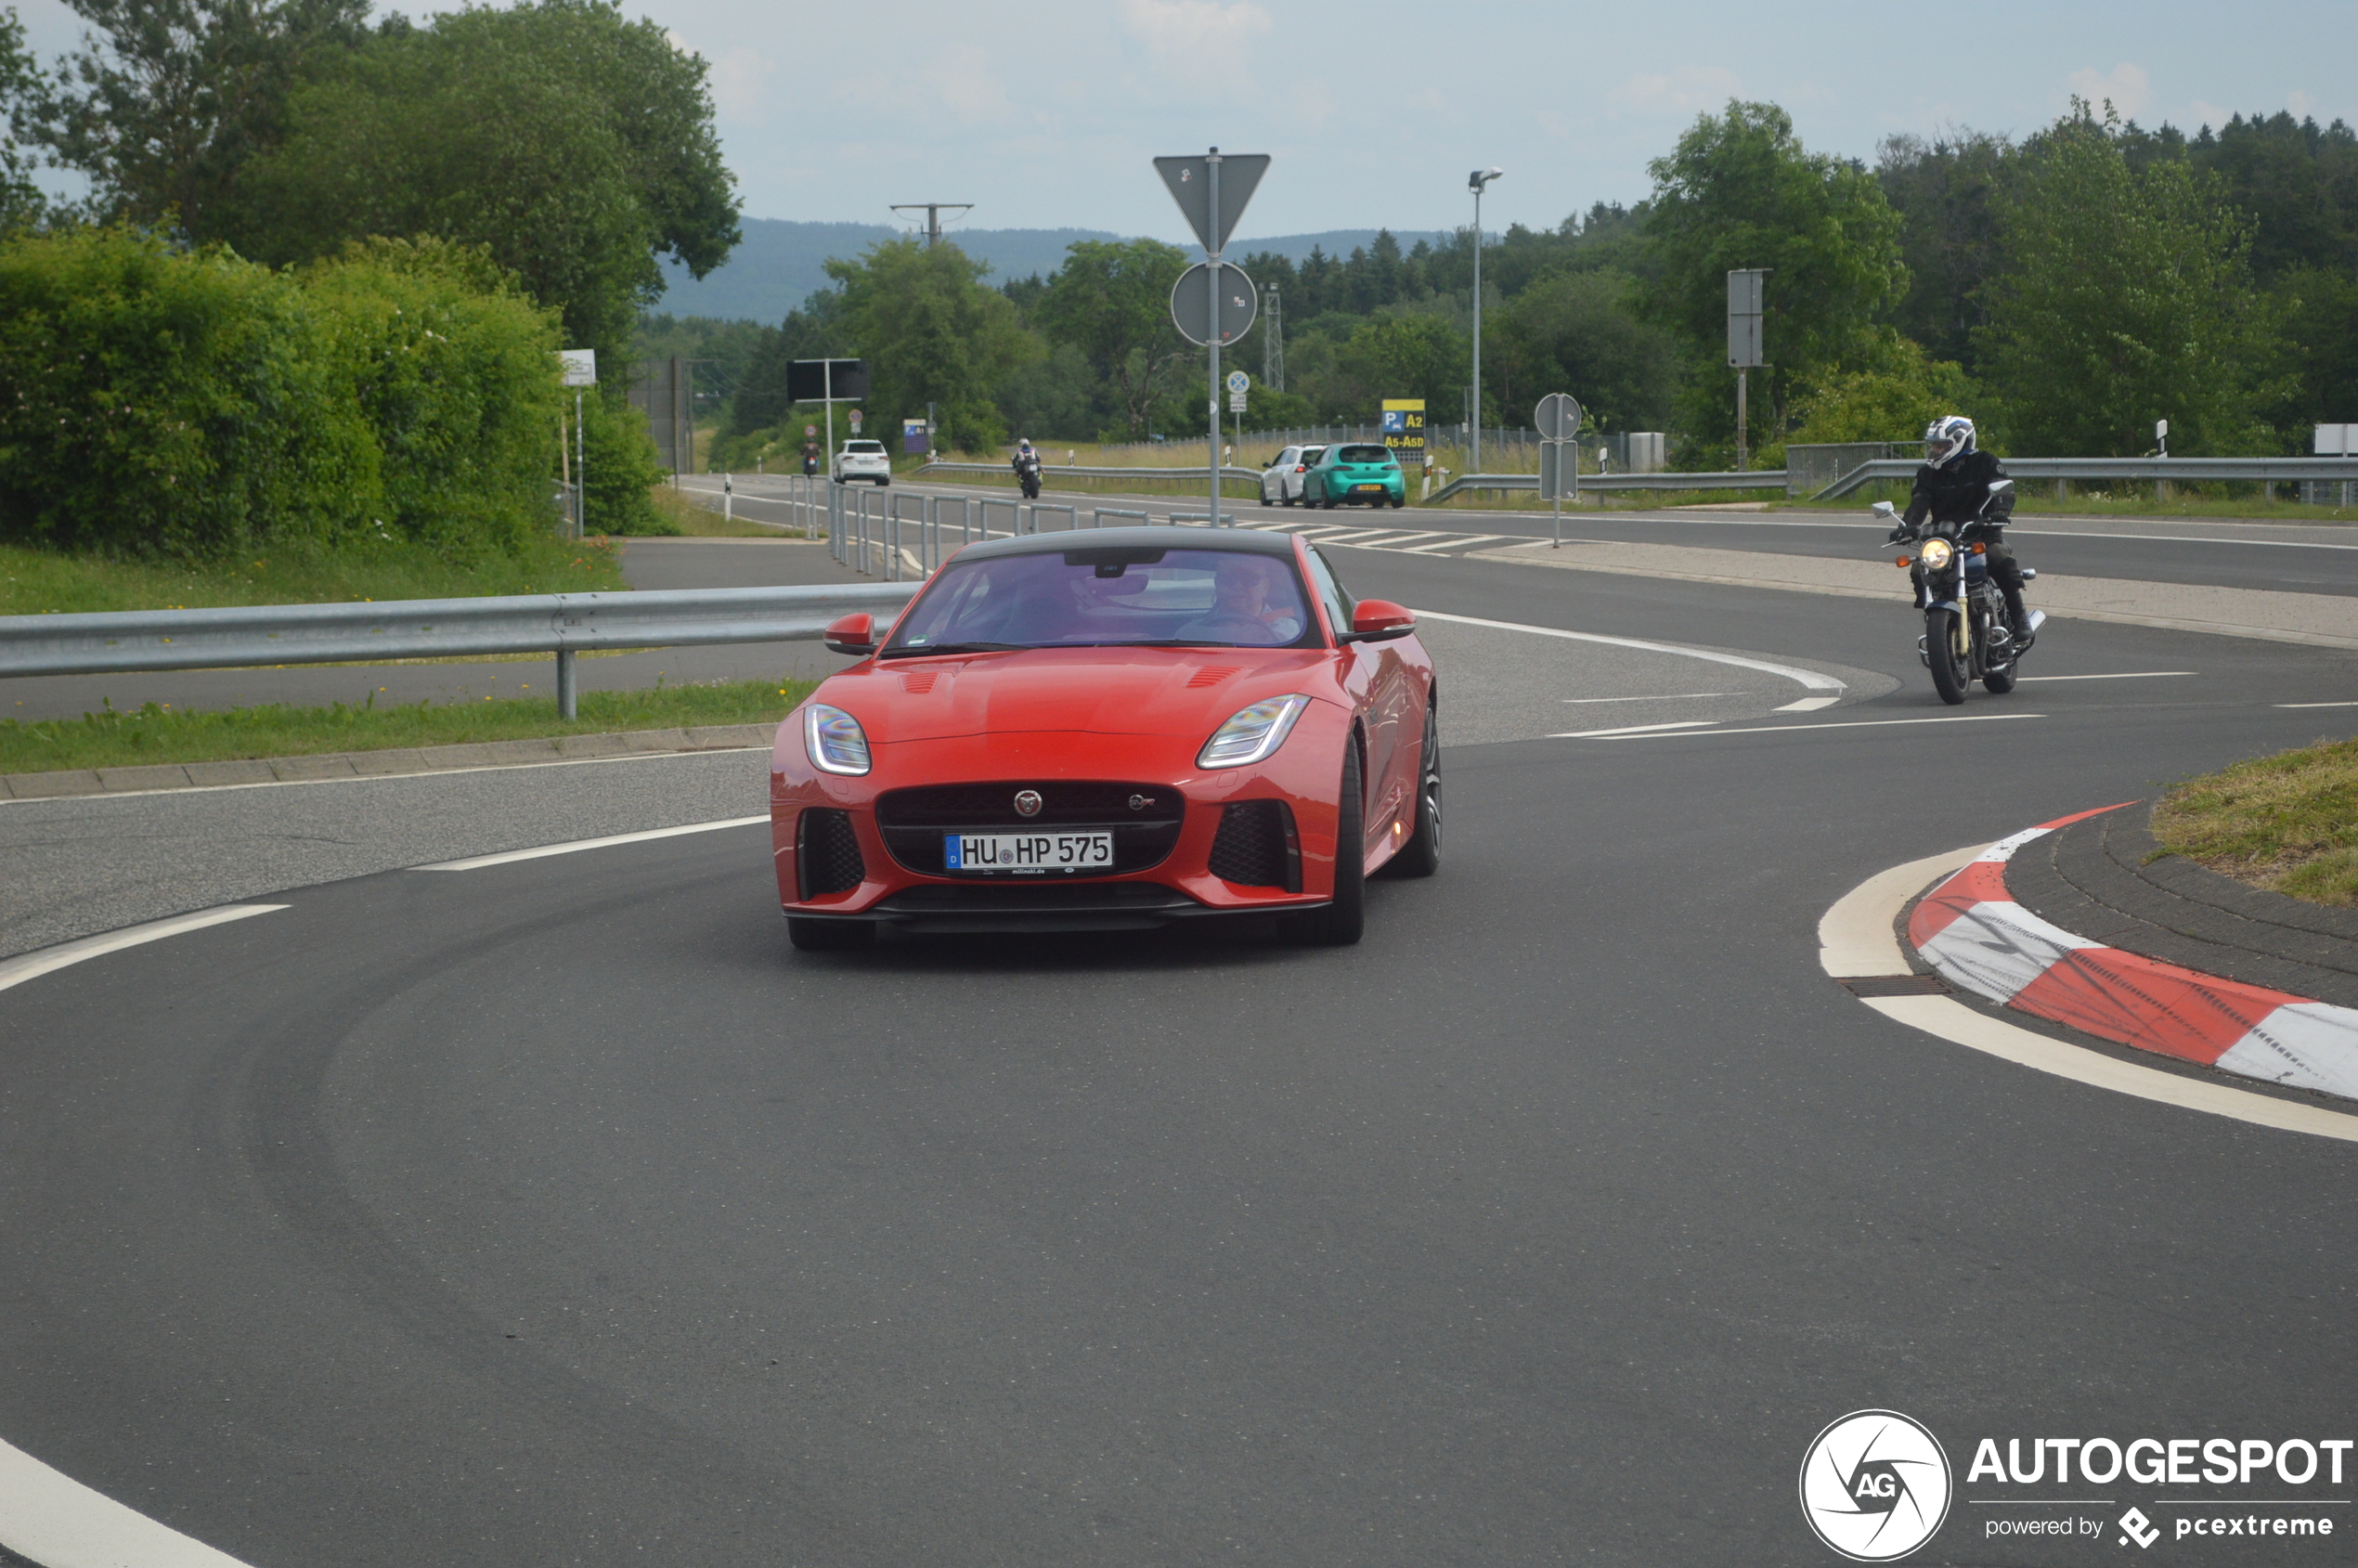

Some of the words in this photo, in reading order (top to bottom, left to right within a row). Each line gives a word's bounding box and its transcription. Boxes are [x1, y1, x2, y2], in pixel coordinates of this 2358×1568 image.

[1406, 414, 1423, 428] A2
[1385, 435, 1424, 447] A5-A5D
[950, 855, 957, 863] D
[962, 838, 997, 864] HU
[1017, 837, 1051, 863] HP
[1058, 836, 1108, 862] 575
